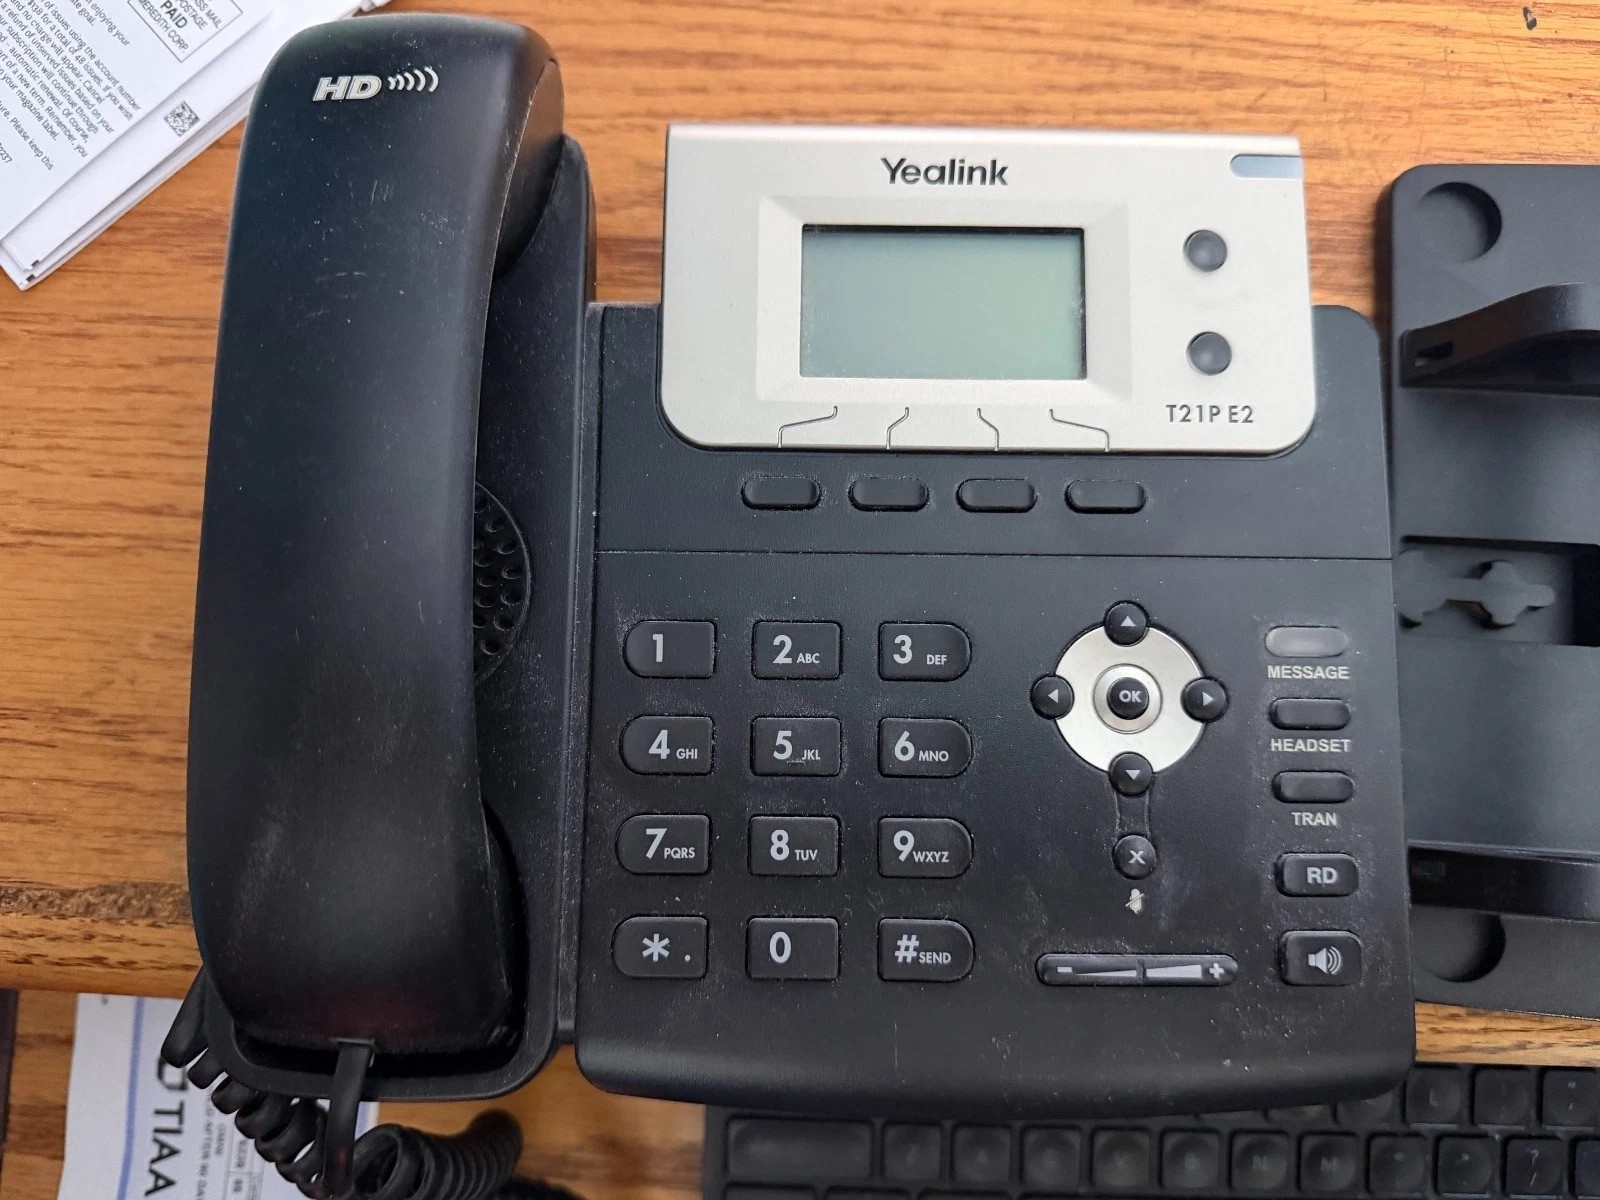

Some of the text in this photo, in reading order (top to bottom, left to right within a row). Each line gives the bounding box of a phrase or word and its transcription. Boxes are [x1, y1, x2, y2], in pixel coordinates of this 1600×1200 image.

[77, 7, 96, 26] goal.
[90, 3, 130, 46] enjoying your
[159, 0, 188, 29] PAID
[204, 9, 222, 29] MAIL
[4, 8, 29, 32] refund
[31, 38, 61, 70] unserved
[56, 66, 77, 90] issues
[74, 87, 96, 110] based
[96, 117, 115, 134] your
[26, 19, 52, 44] charge
[50, 41, 65, 57] will
[58, 55, 84, 82] appear.
[82, 80, 106, 105] Cancel
[40, 13, 53, 26] for
[54, 28, 72, 48] total
[82, 61, 103, 87] issues.
[103, 91, 120, 106] you
[118, 104, 134, 121] wish
[50, 6, 71, 31] issues
[64, 29, 87, 52] using
[84, 46, 96, 60] the
[94, 59, 120, 87] account
[117, 85, 142, 111] number
[6, 26, 43, 68] subscription
[40, 65, 55, 80] will
[51, 78, 78, 109] continue
[70, 106, 99, 134] through
[8, 46, 40, 82] automatic
[37, 80, 64, 110] renewal.
[68, 117, 90, 144] course,
[313, 76, 381, 101] HD
[0, 73, 19, 90] your
[15, 89, 44, 122] magazine
[41, 118, 60, 141] label.
[16, 73, 32, 89] new
[29, 87, 46, 108] term.
[44, 106, 77, 146] Remember,
[73, 144, 88, 158] you
[9, 117, 30, 142] Please
[28, 138, 44, 158] keep
[40, 155, 54, 171] this
[881, 158, 1007, 186] Yealink
[653, 634, 663, 662] 1
[773, 635, 819, 664] 2 ABC
[893, 635, 947, 665] 3 DEF
[1268, 665, 1350, 680] MESSAGE
[1119, 690, 1142, 702] OK
[649, 730, 697, 759] 4 GHI
[773, 731, 820, 760] 5 JKL
[895, 731, 949, 761] 6 MNO
[1271, 739, 1352, 752] HEADSET
[1292, 812, 1337, 827] TRAN
[646, 828, 695, 858] 7 PQRS
[770, 830, 817, 860] 8 TUV
[894, 830, 949, 862] 9 WXYZ
[1307, 867, 1337, 883] RD
[770, 932, 791, 963] 0
[919, 952, 951, 964] SEND
[144, 1102, 185, 1197] TIAA
